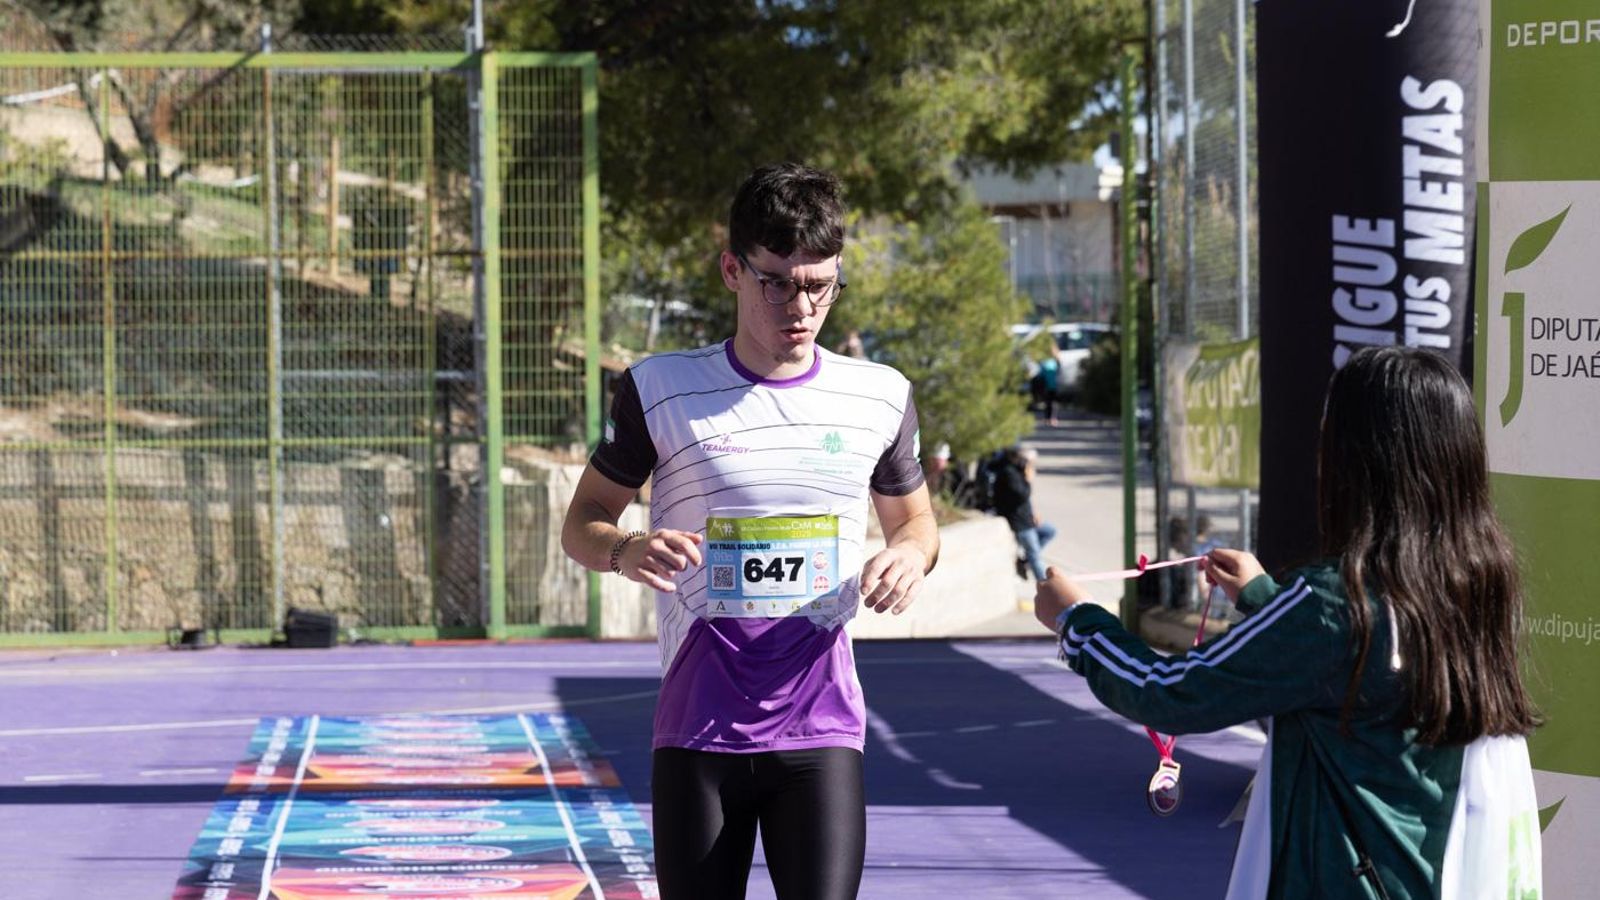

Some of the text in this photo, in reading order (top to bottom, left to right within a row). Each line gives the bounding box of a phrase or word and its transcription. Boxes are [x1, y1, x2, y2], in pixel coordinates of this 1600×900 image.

[1507, 19, 1600, 47] DEPOR
[1401, 75, 1464, 349] TUS METAS
[1331, 214, 1398, 370] IGUE
[1531, 317, 1600, 341] DIPUT
[1531, 350, 1600, 378] DE JAÉ
[702, 443, 750, 455] TEAMERGY
[743, 557, 804, 583] 647
